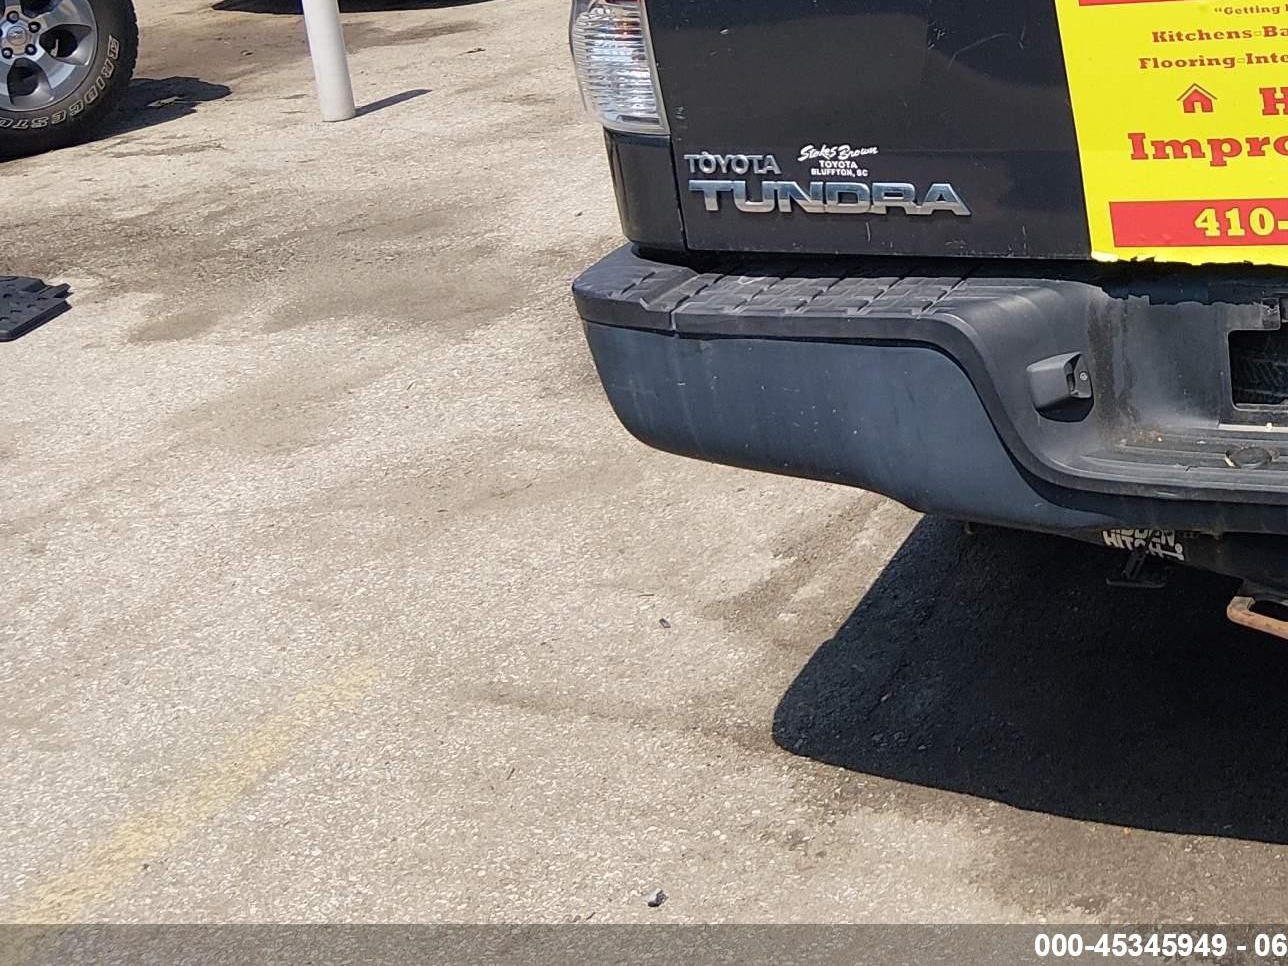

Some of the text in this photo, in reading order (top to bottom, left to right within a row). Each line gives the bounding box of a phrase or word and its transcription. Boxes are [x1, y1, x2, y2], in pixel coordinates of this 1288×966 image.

[797, 144, 879, 161] Stokes Brown
[683, 153, 782, 175] TOYOTA
[818, 159, 859, 170] TOYOTA
[857, 168, 869, 177] SC
[687, 179, 972, 216] TUNDRA
